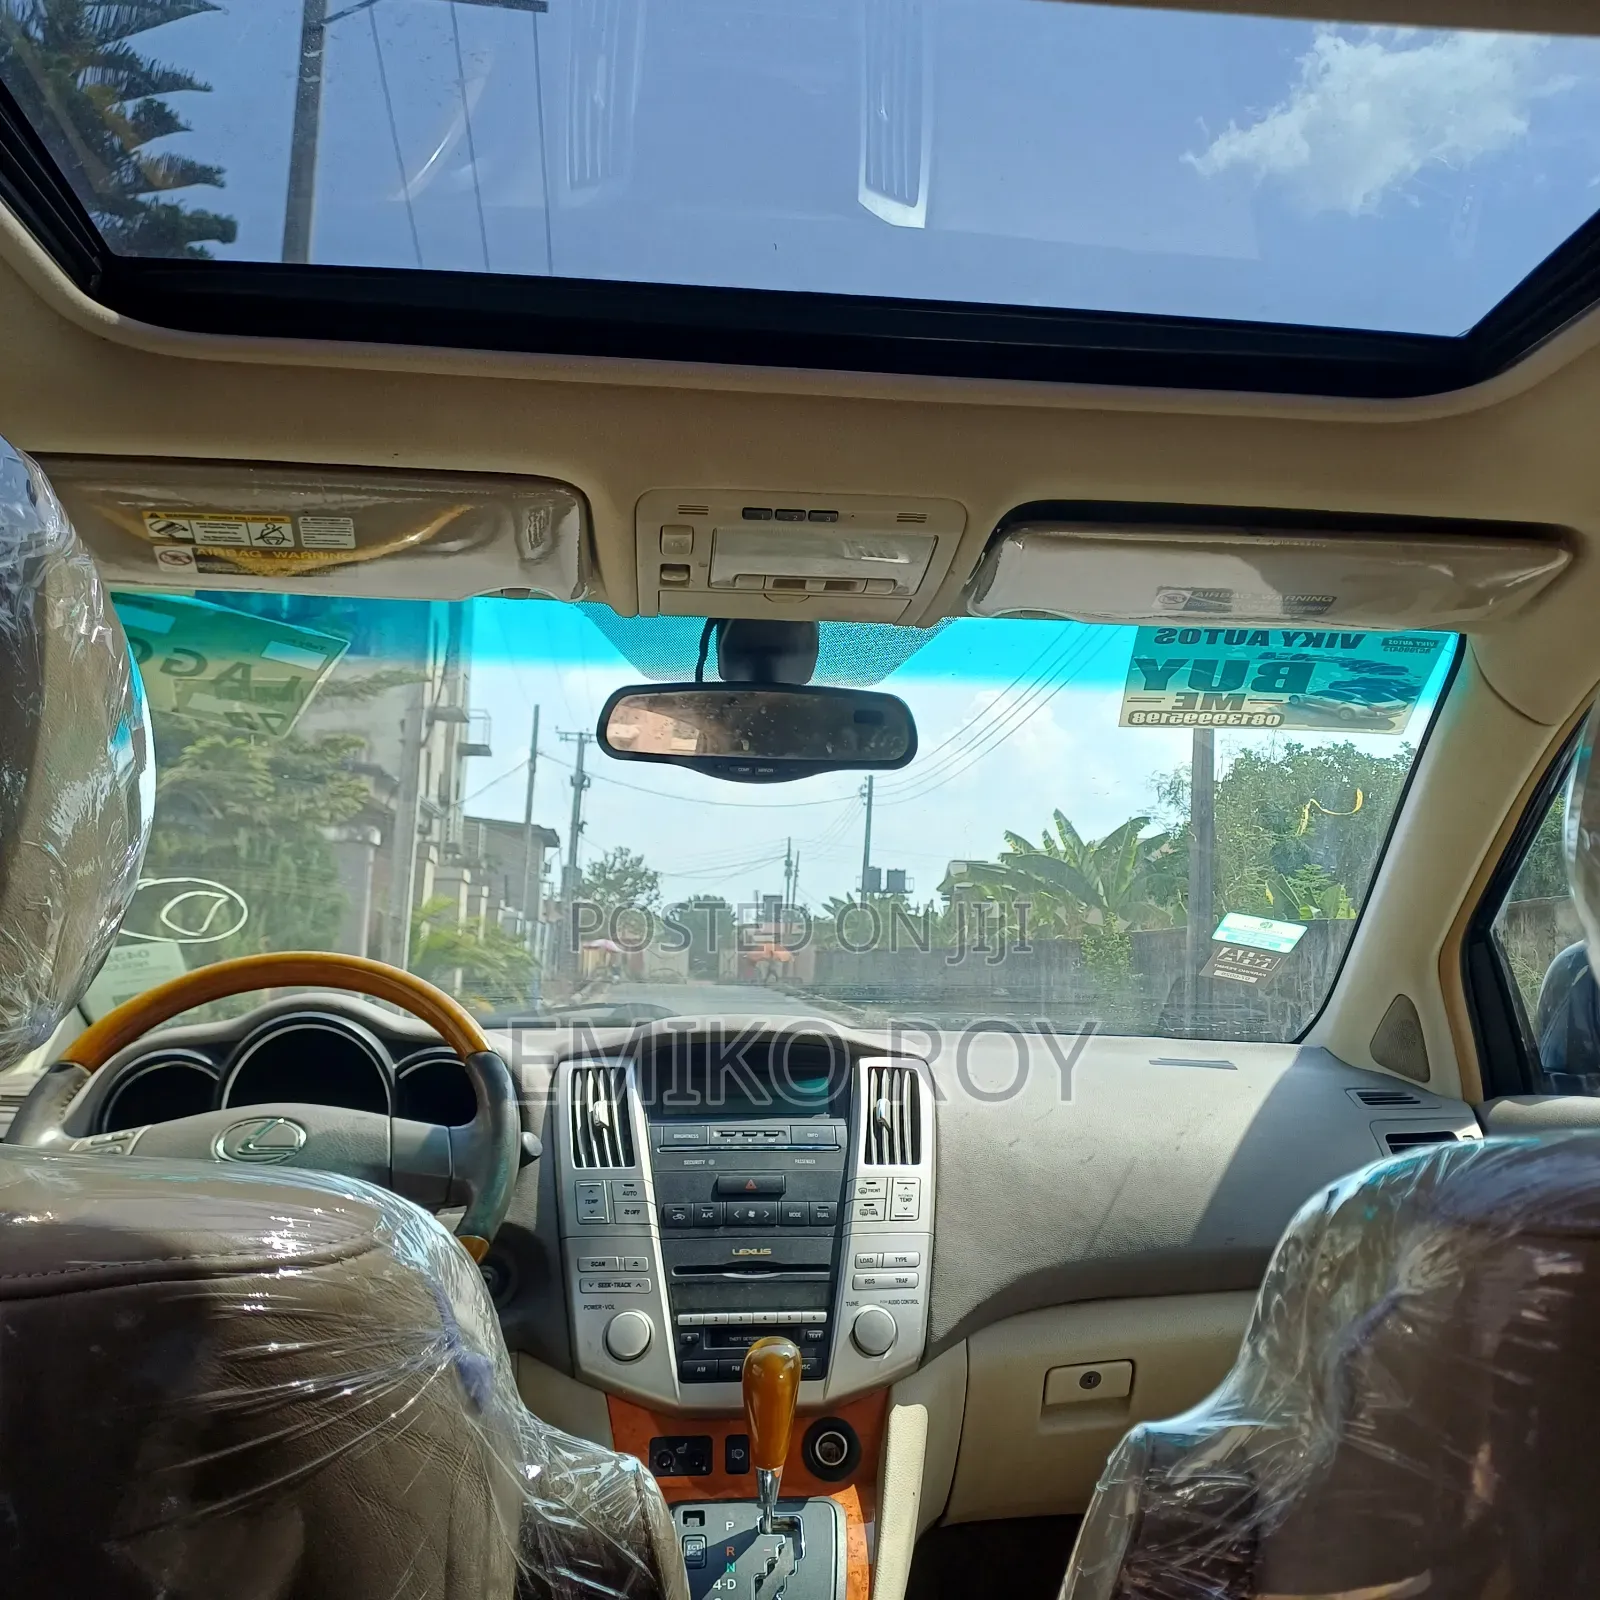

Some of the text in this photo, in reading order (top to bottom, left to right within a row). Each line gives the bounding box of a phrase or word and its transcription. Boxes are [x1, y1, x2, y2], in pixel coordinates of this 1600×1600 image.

[197, 548, 354, 560] AIRBAG WARNING
[1261, 593, 1333, 602] WARNING
[725, 1521, 735, 1531] P
[726, 1546, 735, 1557] R
[726, 1562, 736, 1573] N
[712, 1578, 737, 1591] 4-D
